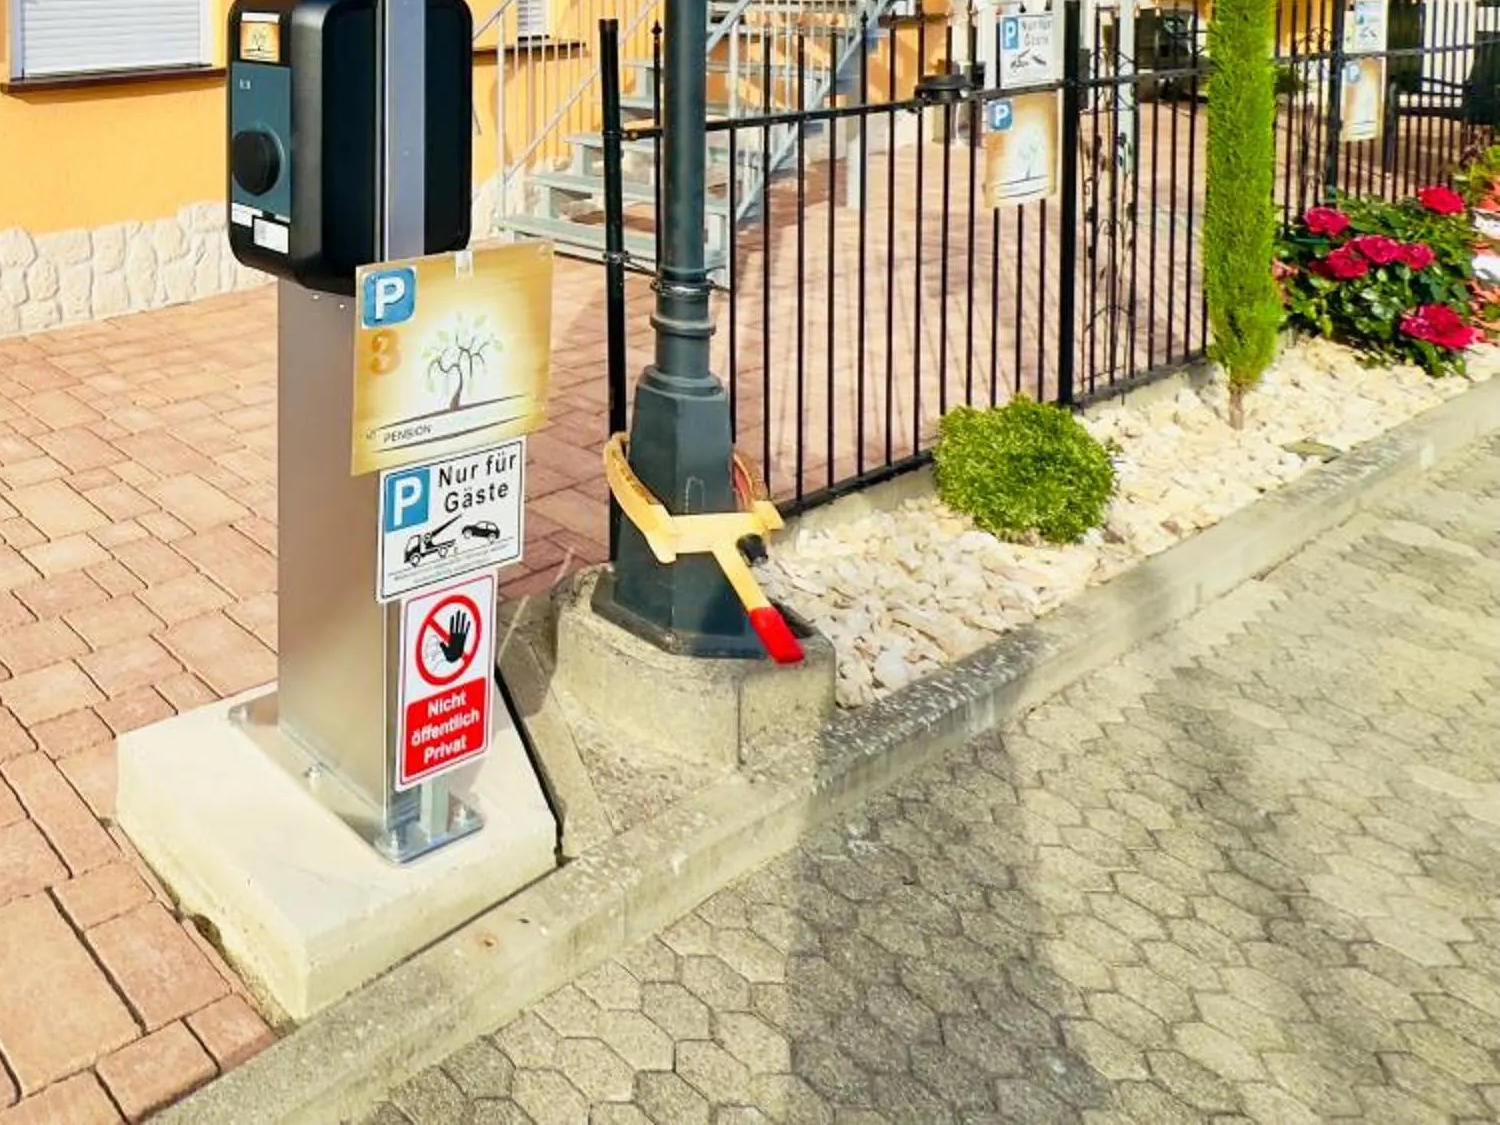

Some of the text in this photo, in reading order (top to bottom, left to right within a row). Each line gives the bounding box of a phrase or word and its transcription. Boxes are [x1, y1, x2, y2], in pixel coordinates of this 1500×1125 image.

[1005, 21, 1017, 48] P
[995, 104, 1009, 127] P
[375, 276, 405, 320] P
[438, 451, 517, 487] Nur für
[393, 475, 422, 526] P
[445, 482, 509, 513] Gäste
[427, 691, 467, 718] Nicht
[412, 708, 480, 747] öffentlich
[424, 735, 467, 764] Privat
